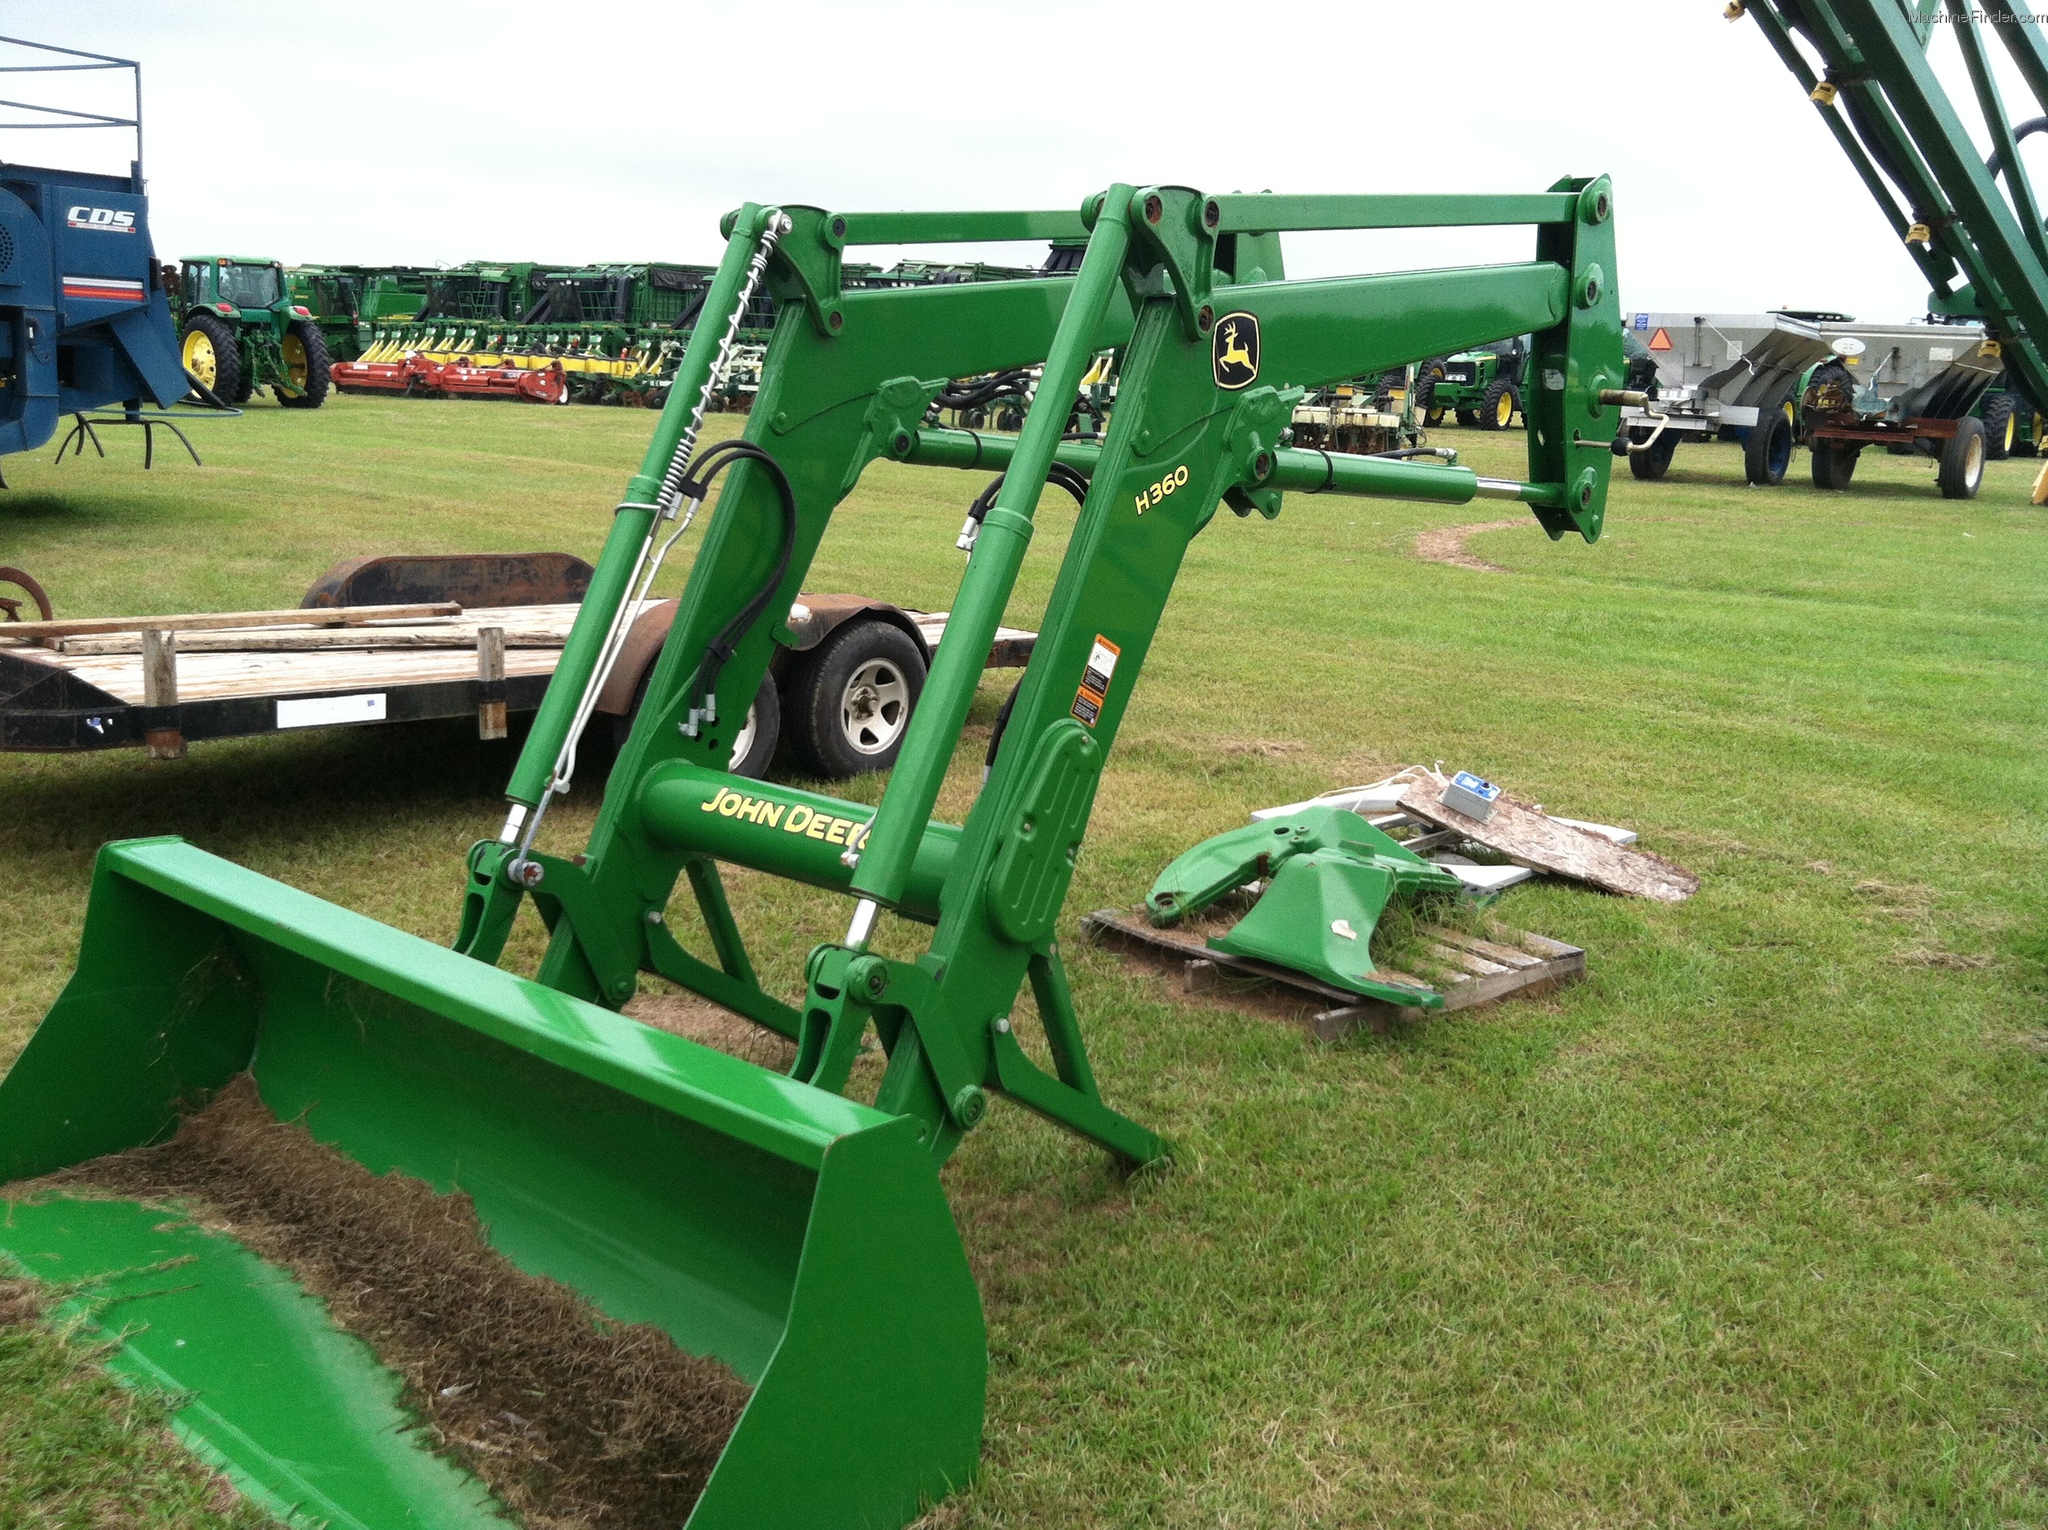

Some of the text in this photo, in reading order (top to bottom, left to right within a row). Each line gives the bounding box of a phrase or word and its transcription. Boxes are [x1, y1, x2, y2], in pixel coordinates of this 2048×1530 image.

[67, 206, 136, 227] CDS
[1134, 465, 1189, 516] H360
[701, 786, 872, 850] JOHN DEER
